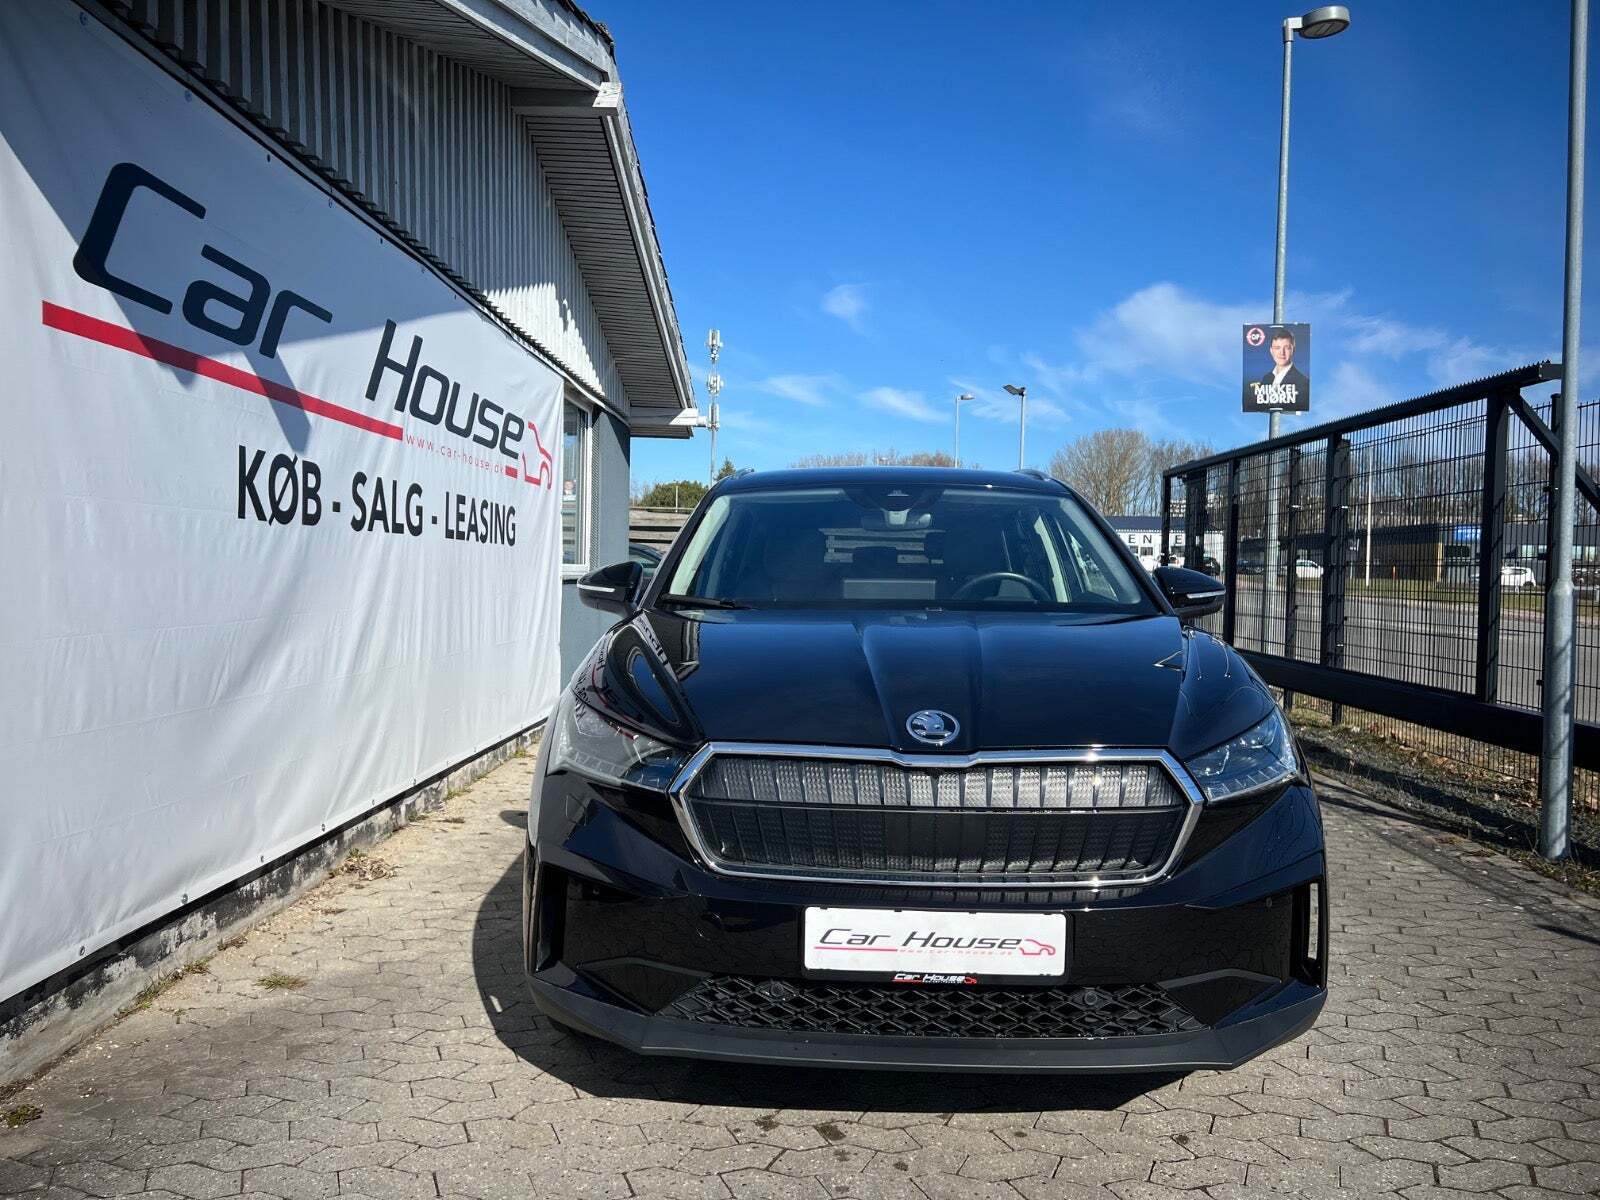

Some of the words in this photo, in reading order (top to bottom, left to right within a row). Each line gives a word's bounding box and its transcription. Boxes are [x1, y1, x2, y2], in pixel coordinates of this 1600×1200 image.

[72, 162, 333, 359] Car
[364, 318, 526, 460] House
[1256, 393, 1296, 404] BJØRN
[237, 444, 323, 527] KØB
[350, 471, 423, 537] SALG
[444, 491, 516, 547] LEASING
[819, 928, 891, 946] Car
[901, 931, 1022, 950] House
